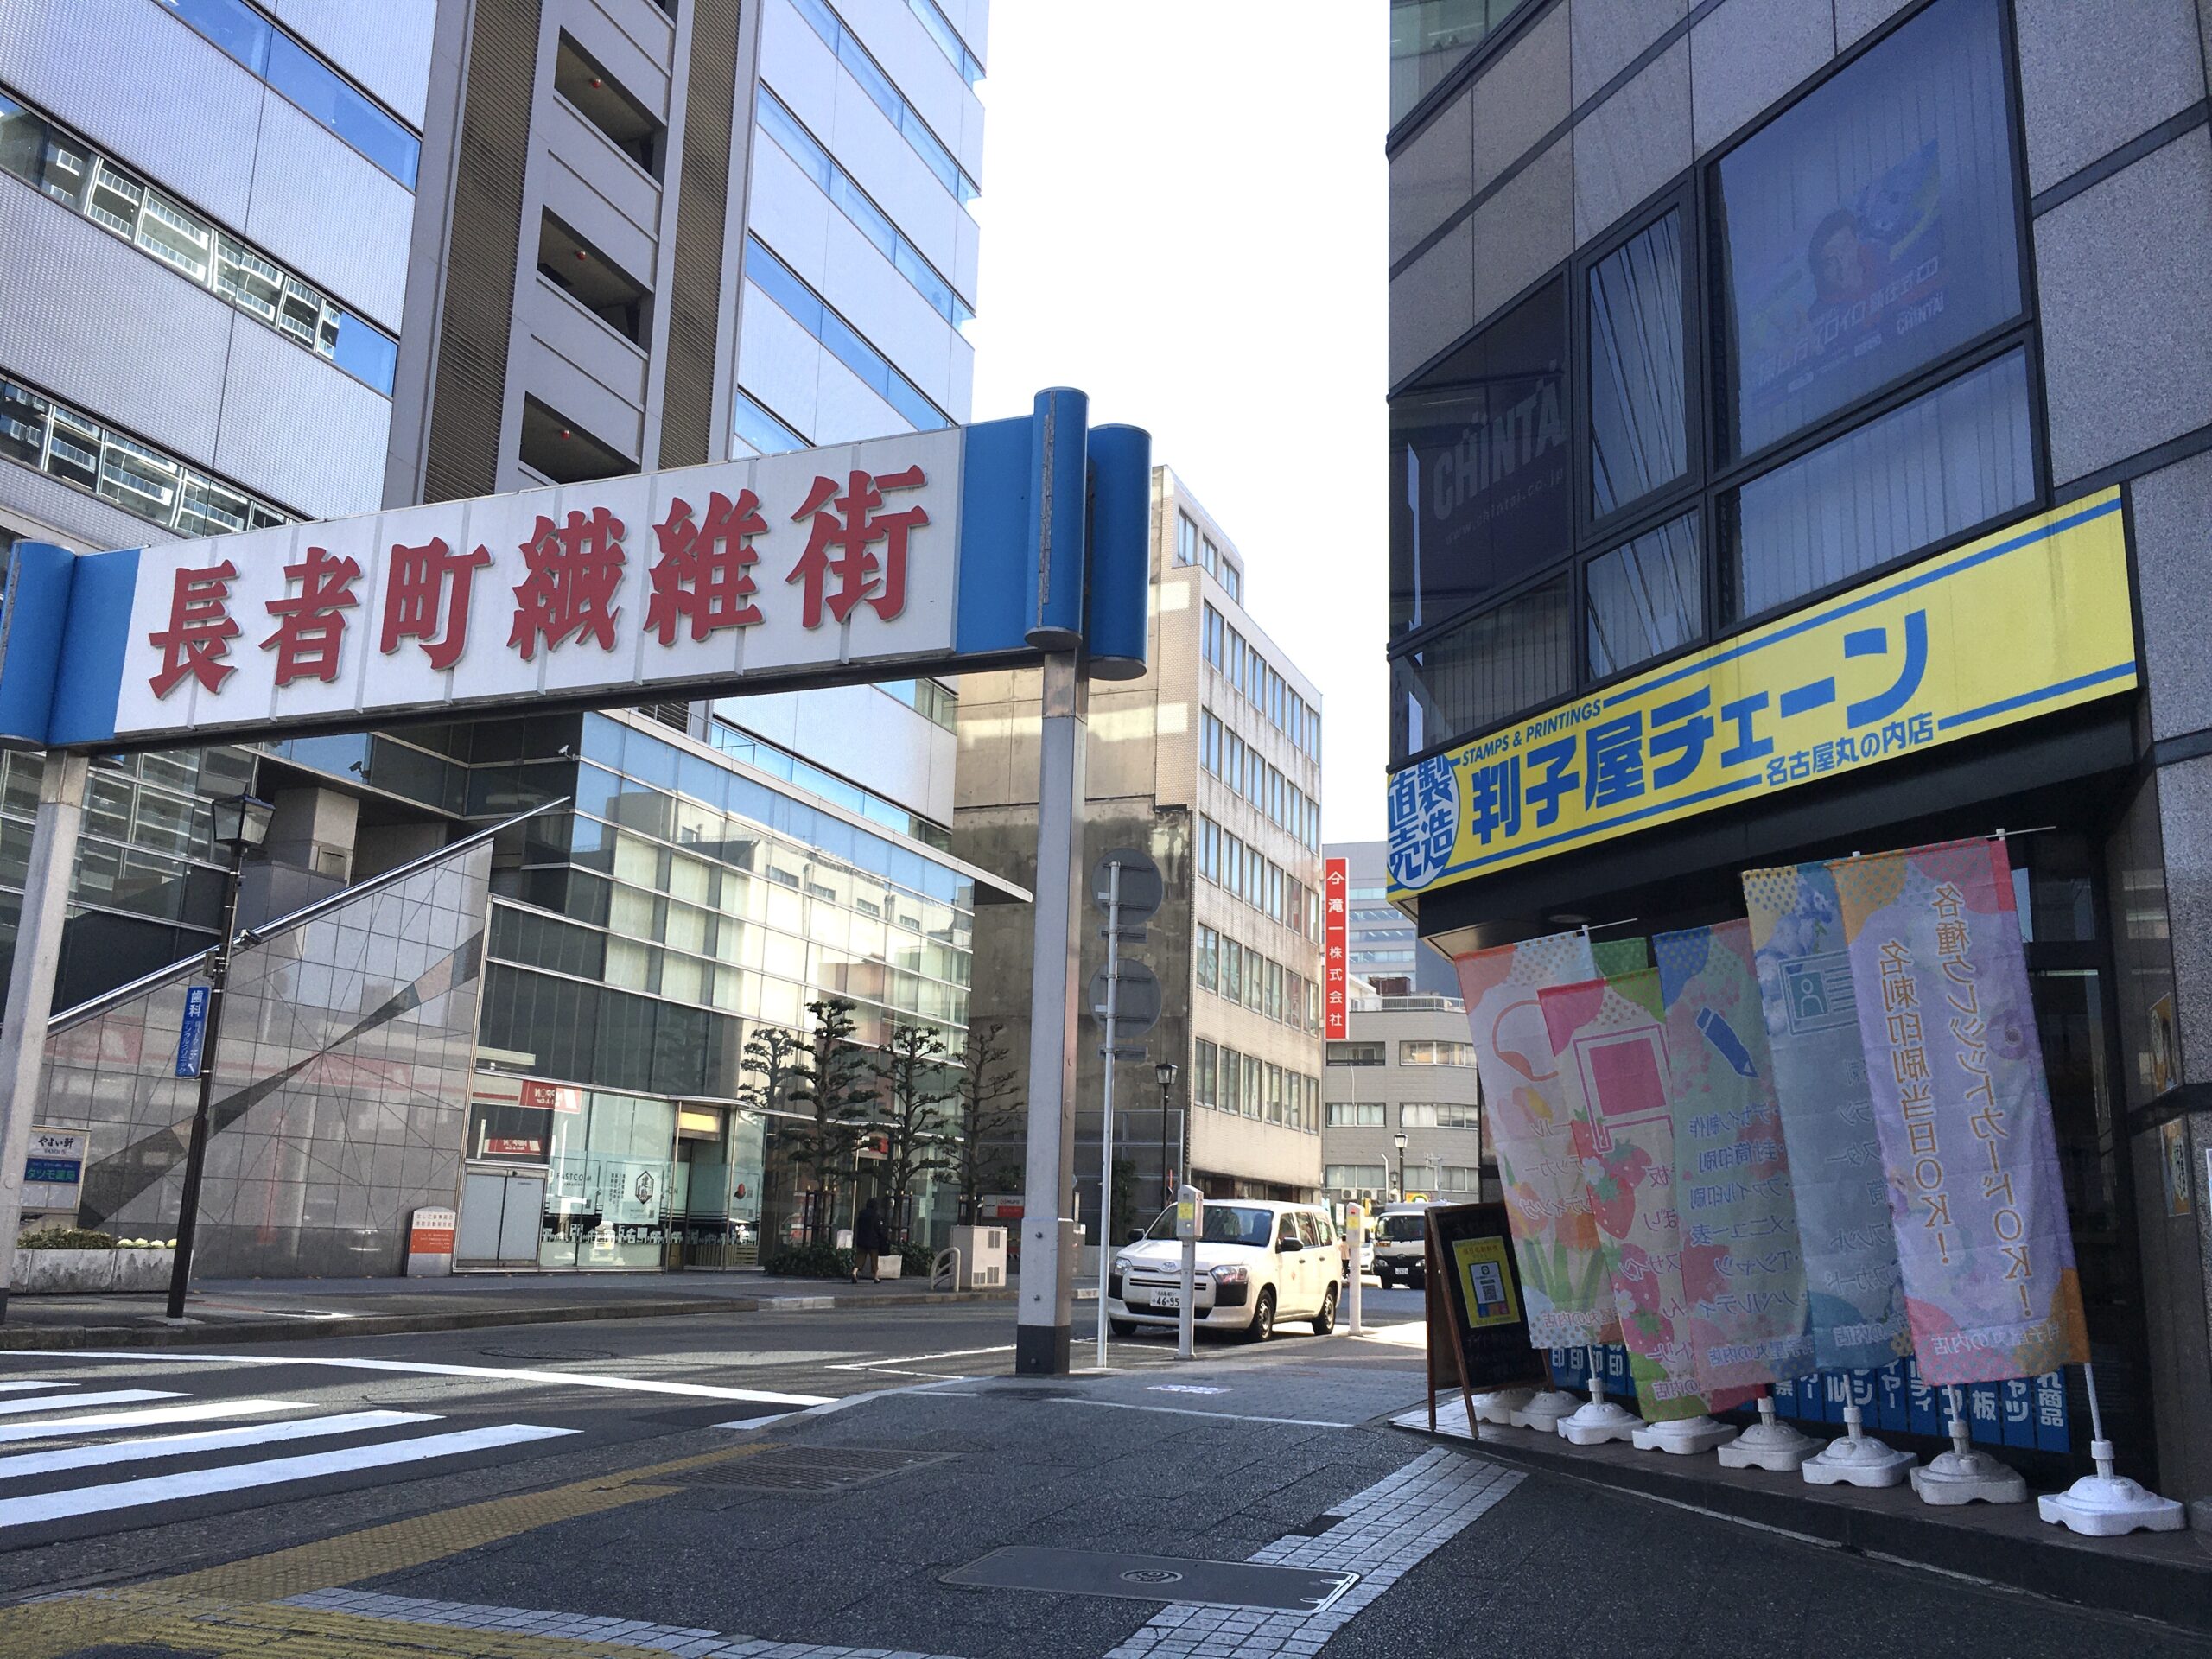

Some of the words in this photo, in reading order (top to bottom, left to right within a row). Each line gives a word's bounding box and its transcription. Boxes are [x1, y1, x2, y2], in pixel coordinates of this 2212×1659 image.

[1462, 735, 1510, 767] STAMPS
[1512, 731, 1523, 747] &
[1526, 698, 1603, 740] PRINTINGS
[1471, 610, 1929, 845] 判子屋チェーン
[1766, 711, 1935, 787] 名古屋丸の内店
[1327, 870, 1345, 1027] 今滝一株式会社
[188, 990, 204, 1018] 歯科
[38, 1135, 74, 1149] やよい軒
